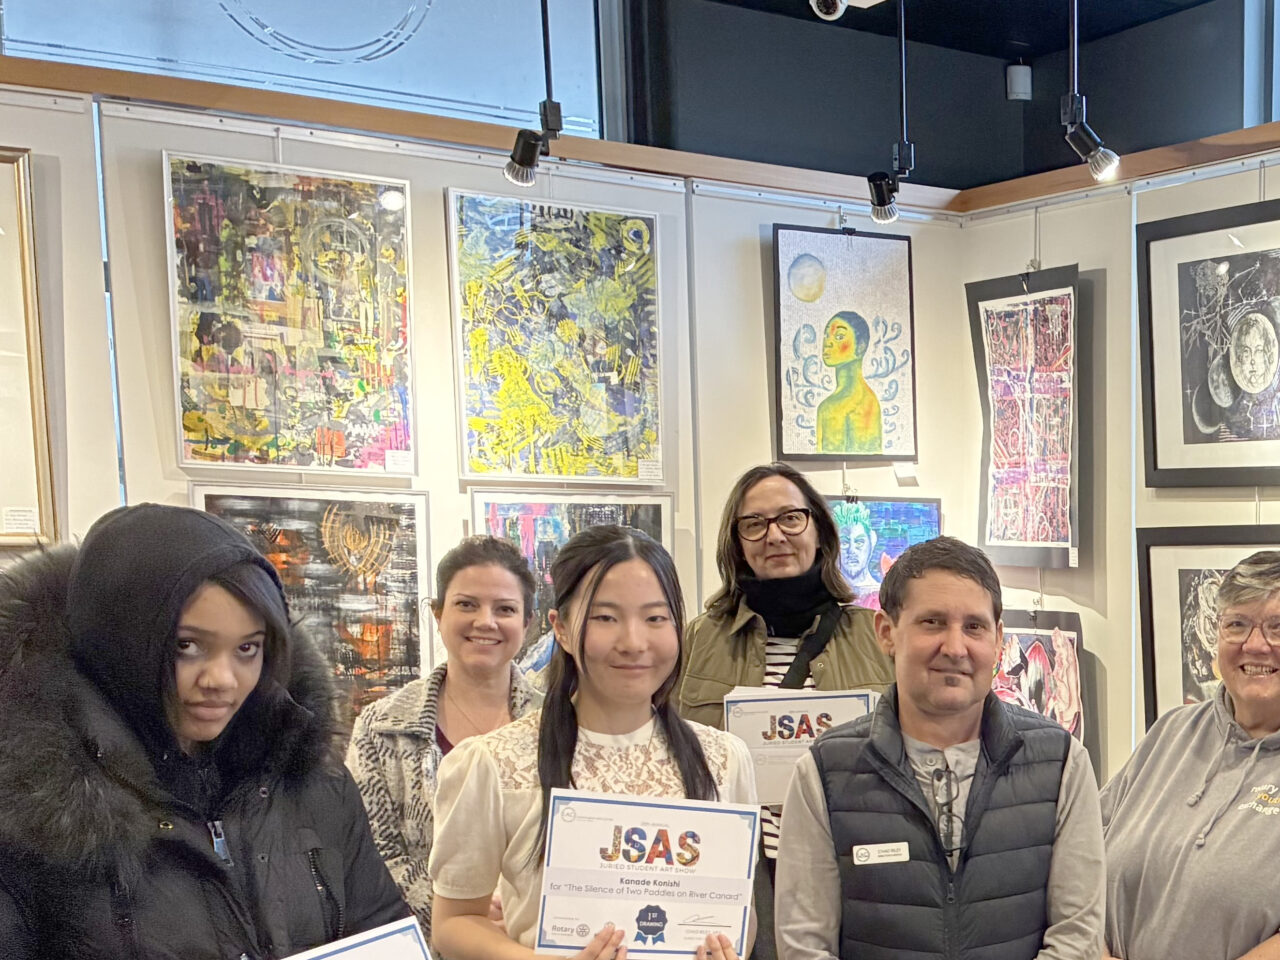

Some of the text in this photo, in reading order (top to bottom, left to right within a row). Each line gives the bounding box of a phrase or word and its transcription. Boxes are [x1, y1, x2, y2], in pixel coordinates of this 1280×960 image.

[762, 713, 832, 740] JSAS
[600, 825, 701, 866] JSAS
[620, 878, 681, 887] Kanade Konishi
[585, 885, 613, 894] Silence
[616, 886, 624, 895] of
[626, 887, 642, 896] Two
[644, 888, 675, 898] Paddles
[689, 891, 707, 899] River
[551, 925, 575, 934] Rotary
